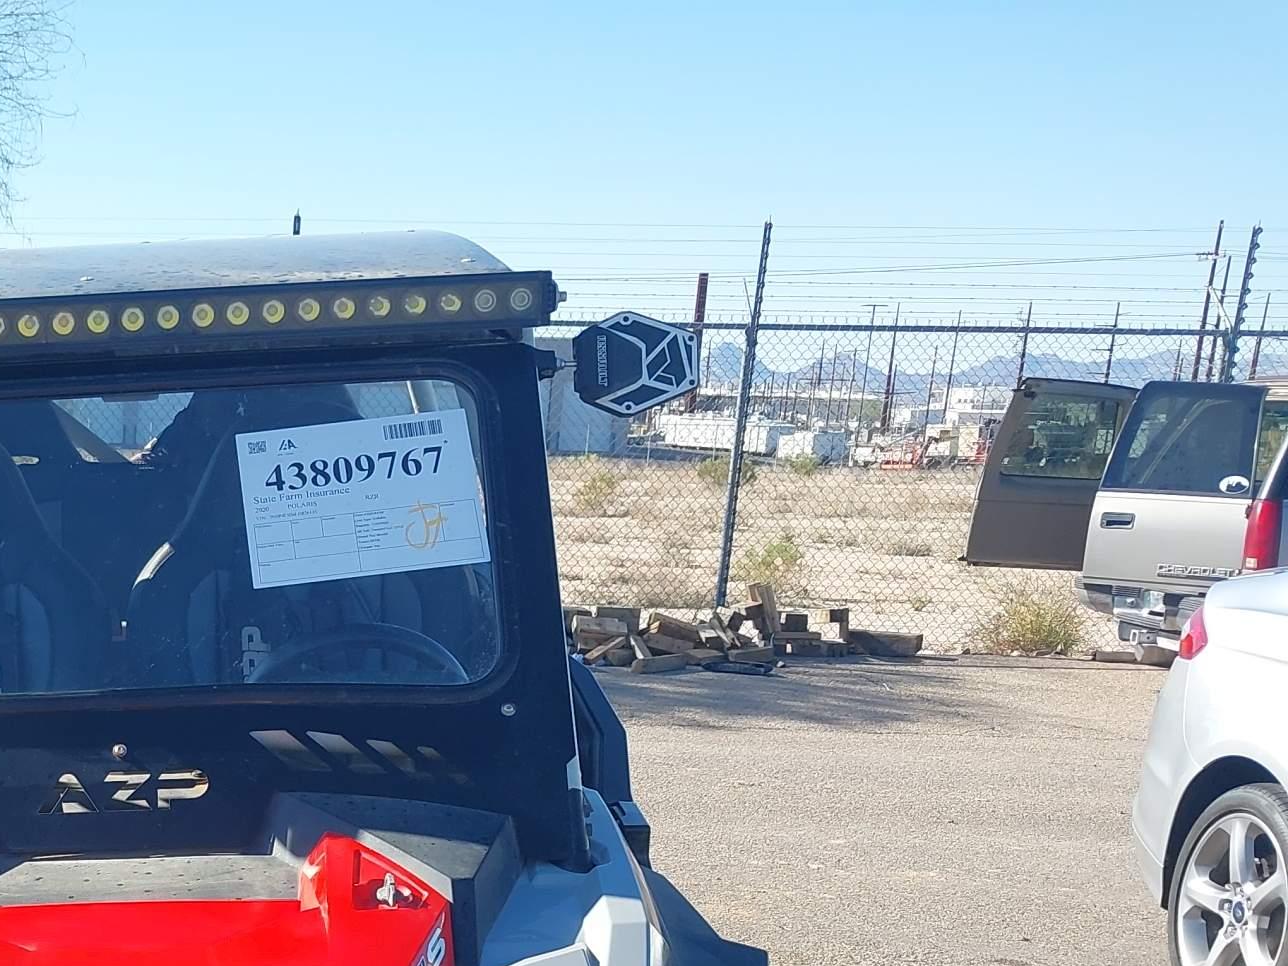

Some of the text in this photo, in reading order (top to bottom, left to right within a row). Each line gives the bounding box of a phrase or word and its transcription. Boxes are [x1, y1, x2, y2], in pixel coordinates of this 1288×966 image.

[265, 446, 443, 492] 43809767
[253, 487, 351, 505] State Farm Insurance
[287, 501, 318, 510] POLARIS
[1157, 563, 1233, 577] CHEVROLET
[38, 768, 210, 815] AZP
